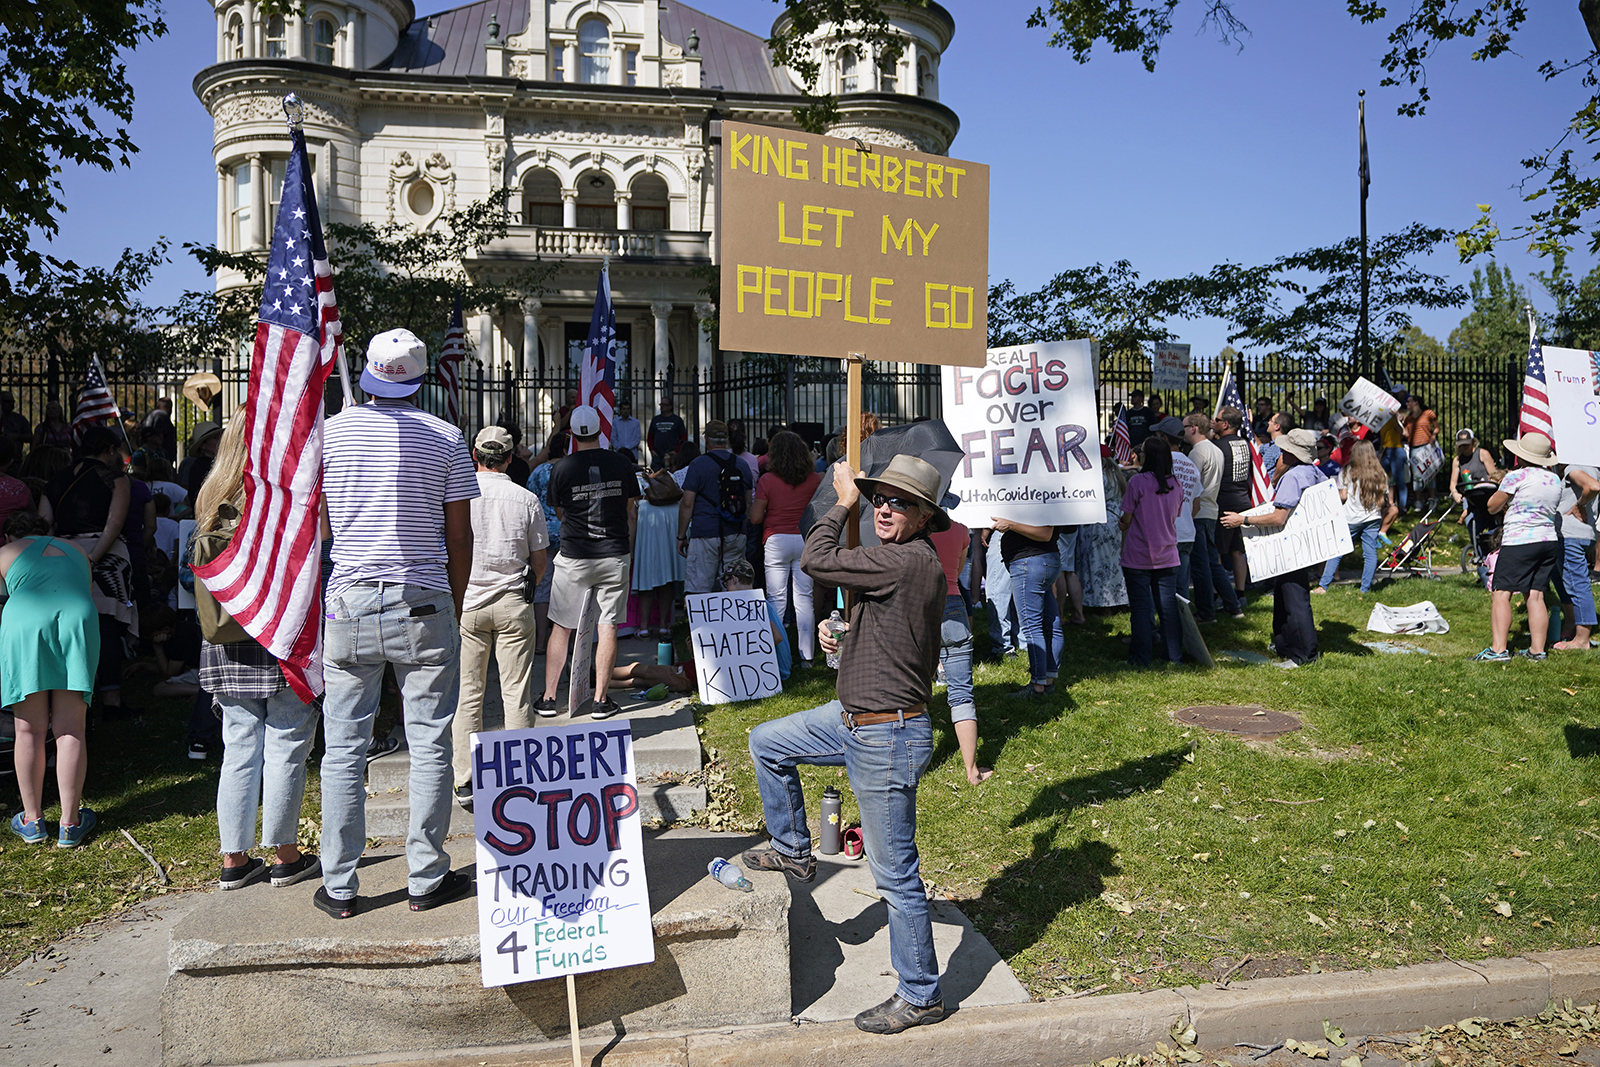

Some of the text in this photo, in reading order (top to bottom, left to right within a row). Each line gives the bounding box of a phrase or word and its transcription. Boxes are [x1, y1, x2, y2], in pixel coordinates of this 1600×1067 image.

[730, 130, 967, 199] KING HERBERT
[778, 201, 940, 256] LET MY
[737, 264, 974, 329] PEOPLE GO
[374, 361, 408, 375] USA
[986, 349, 1029, 366] REAL
[953, 351, 1069, 405] Facts
[1359, 380, 1378, 396] THIS
[1554, 370, 1586, 384] Trump
[986, 400, 1054, 425] over
[1342, 398, 1382, 428] GAME
[1360, 395, 1374, 408] NO
[1583, 401, 1600, 426] S
[961, 424, 1093, 478] FEAR
[960, 486, 1097, 504] UtahCovidreport.com
[1300, 490, 1332, 524] YOUR
[1252, 520, 1340, 579] LOCAL POLICE!
[688, 596, 766, 624] HERBERT
[698, 629, 773, 659] HATES
[703, 662, 779, 702] KIDS
[475, 729, 631, 790] HERBERT
[483, 782, 640, 856] STOP
[484, 858, 630, 902] TRADING
[541, 893, 610, 918] Freedom
[496, 931, 528, 974] 4
[536, 942, 608, 974] Funds
